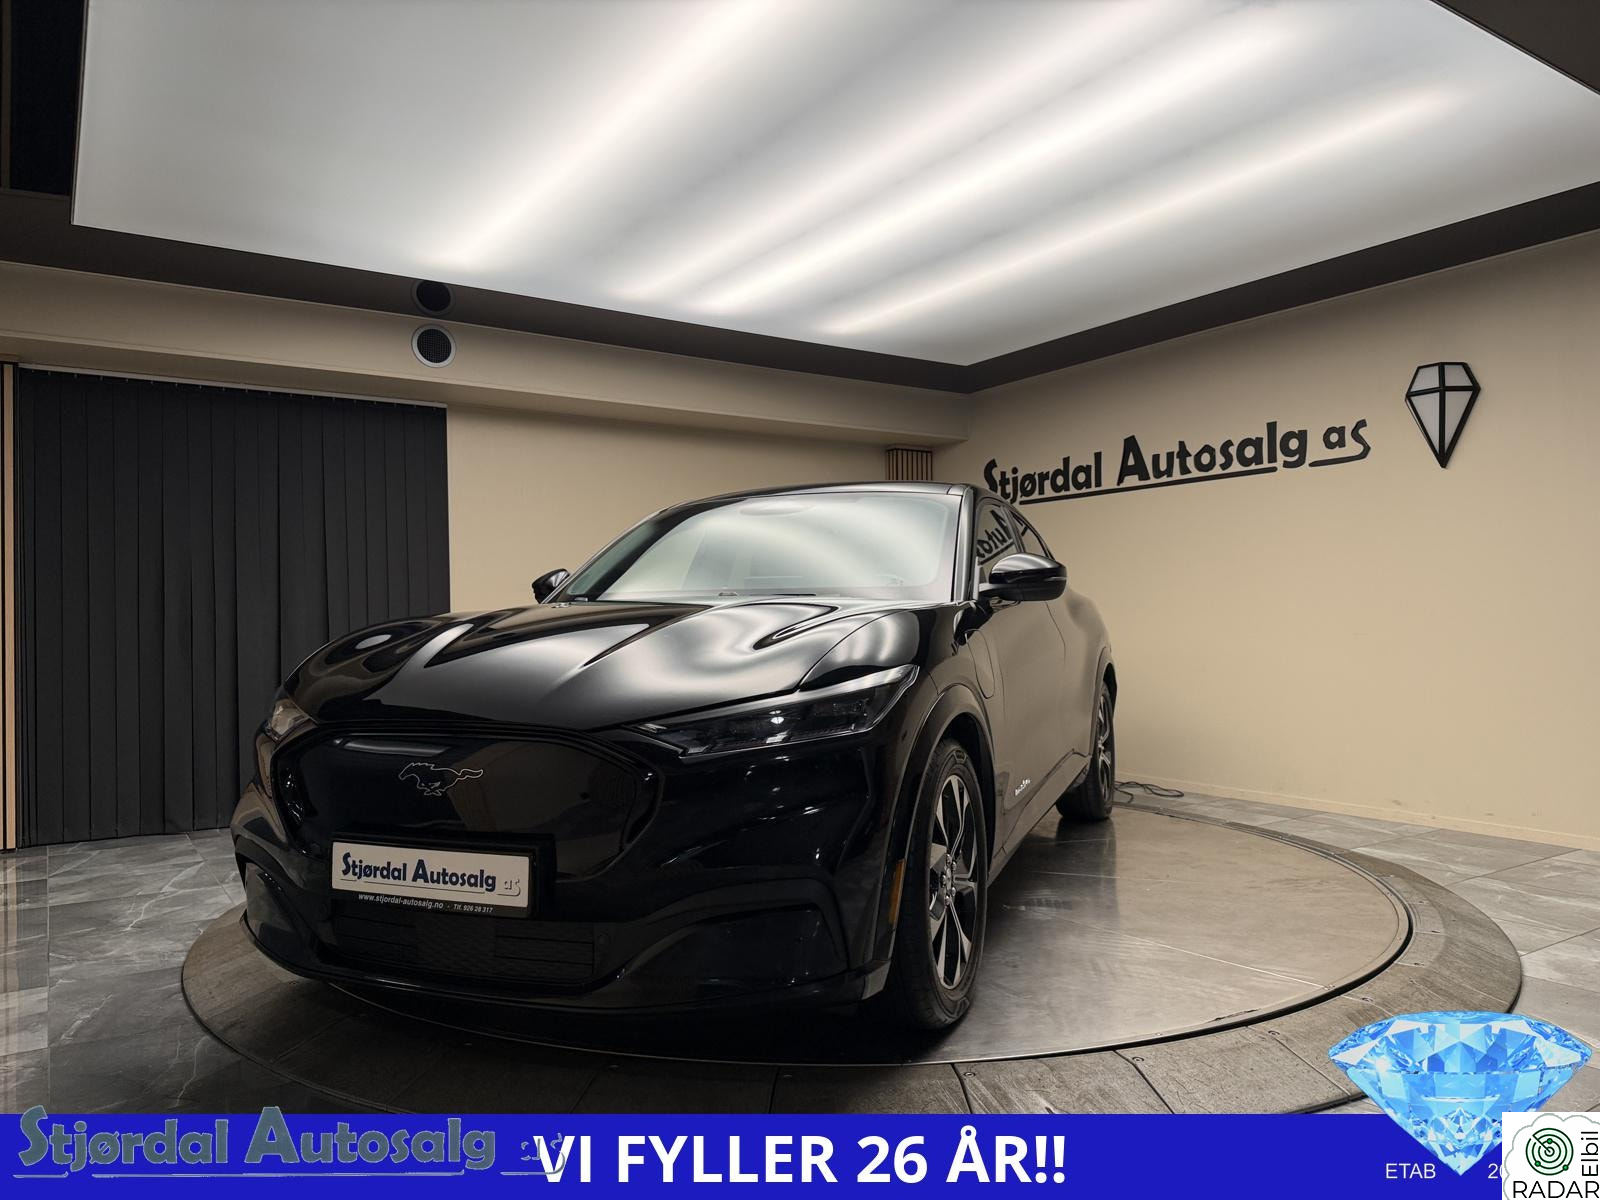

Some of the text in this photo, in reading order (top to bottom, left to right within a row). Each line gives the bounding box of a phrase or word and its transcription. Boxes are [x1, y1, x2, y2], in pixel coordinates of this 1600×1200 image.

[984, 418, 1371, 505] Stjørdal Autosalg as
[341, 852, 407, 881] Stjørdal
[412, 859, 496, 892] Autosalg
[358, 893, 444, 910] www.stjordal-autosalg.no
